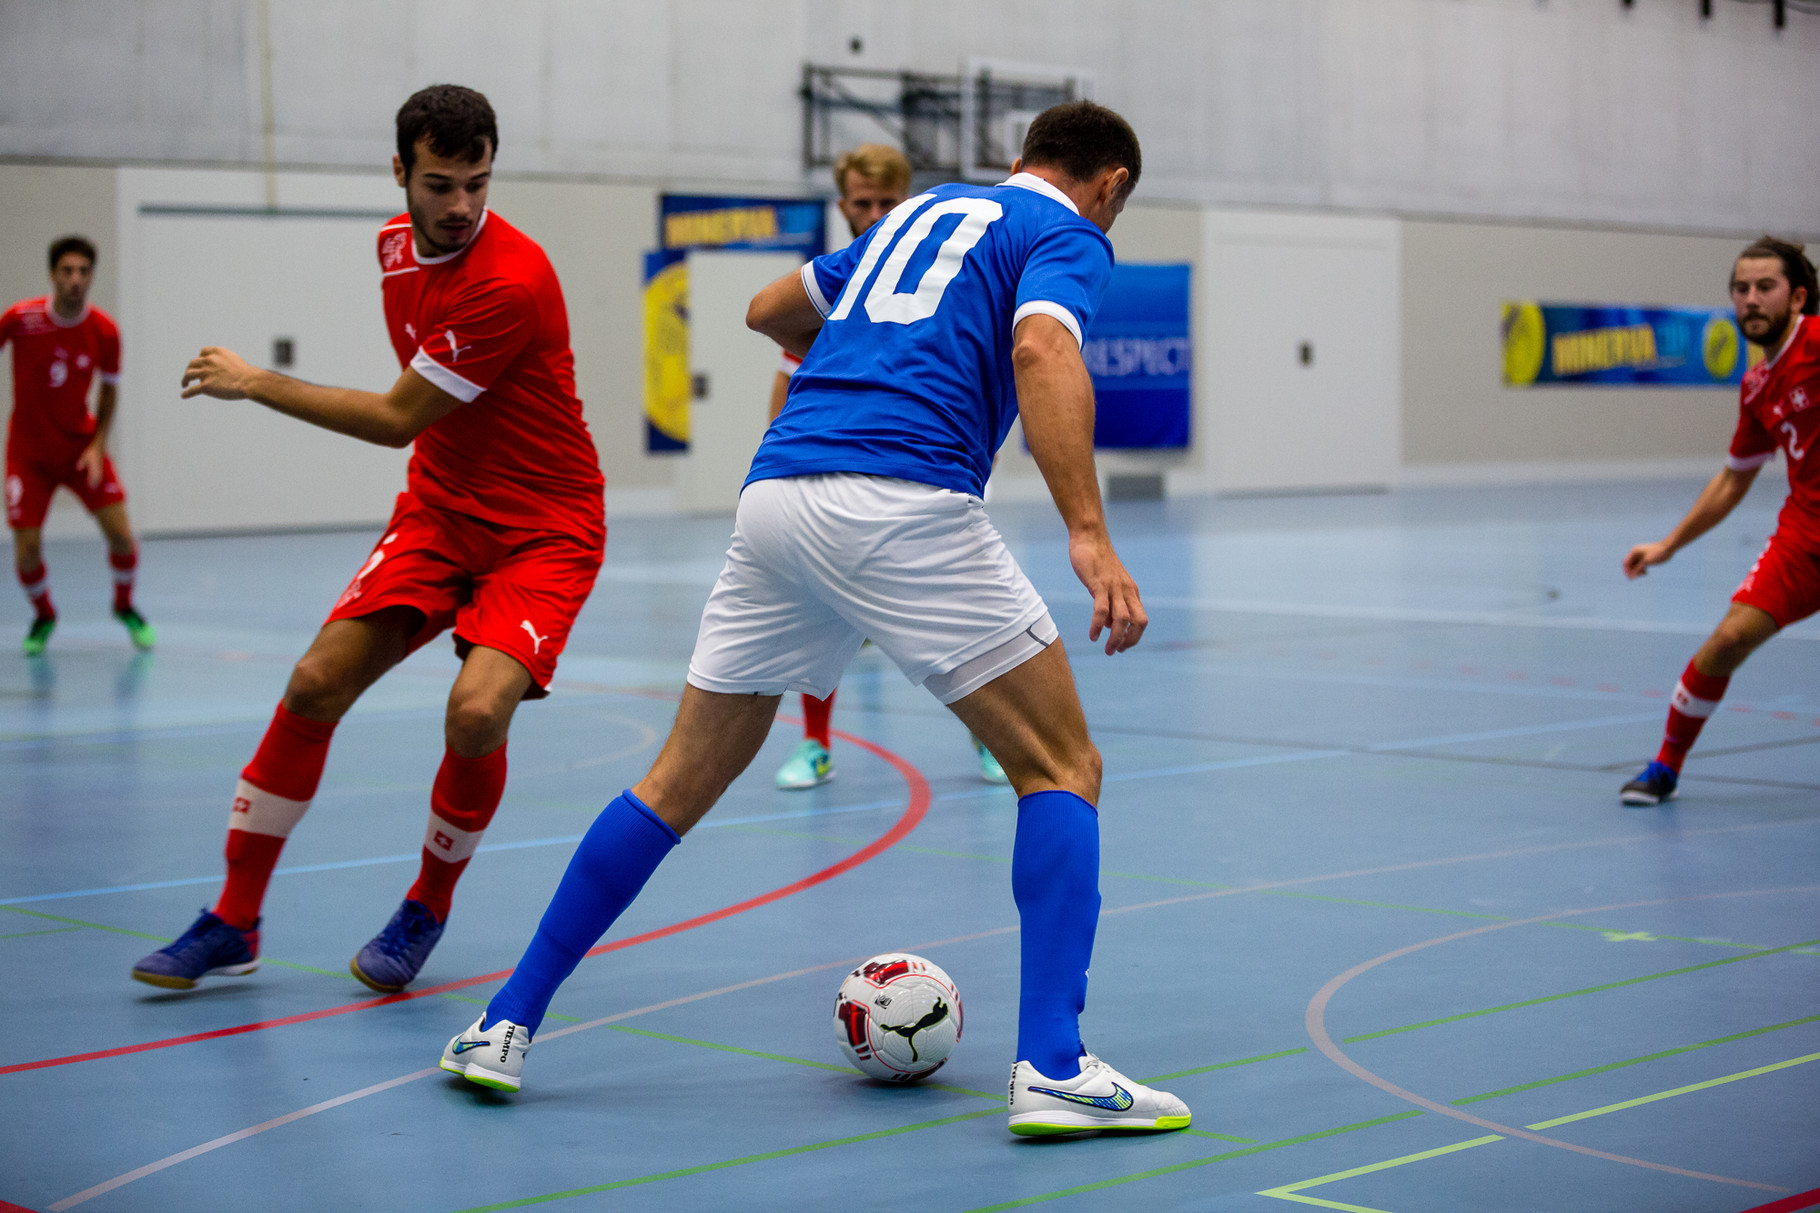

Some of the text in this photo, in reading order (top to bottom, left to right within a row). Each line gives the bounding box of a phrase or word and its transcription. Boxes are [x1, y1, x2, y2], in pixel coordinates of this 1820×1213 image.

[827, 193, 1003, 325] 10
[49, 360, 68, 388] 9
[1780, 421, 1805, 460] 2
